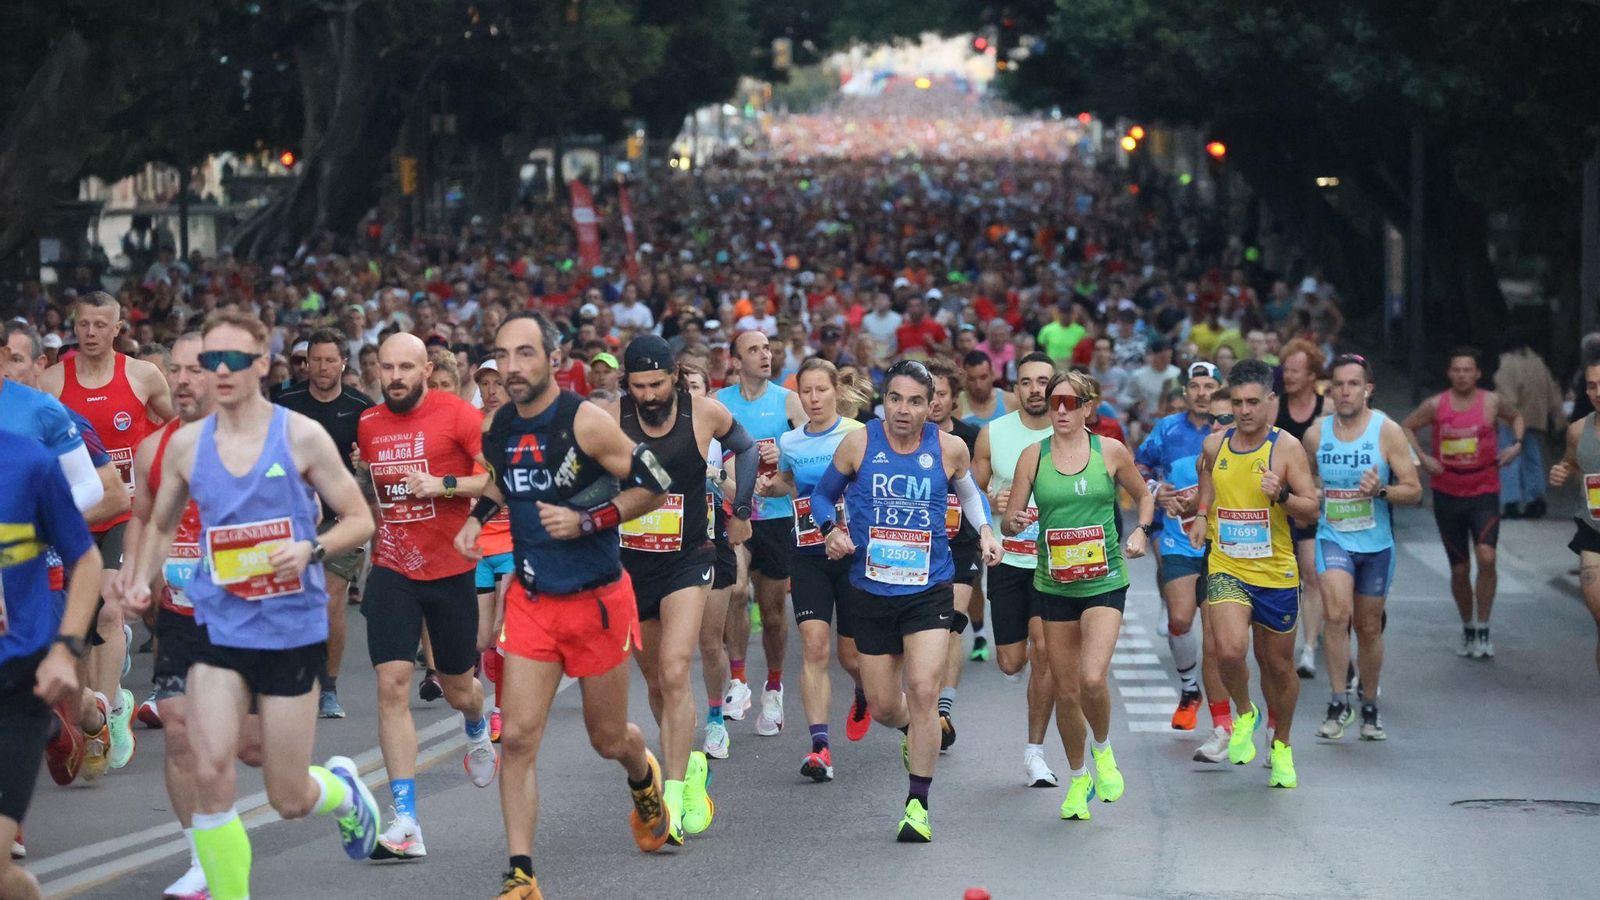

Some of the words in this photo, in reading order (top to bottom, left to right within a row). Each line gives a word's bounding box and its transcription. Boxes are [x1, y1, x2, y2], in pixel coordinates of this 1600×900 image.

[378, 447, 412, 462] MÁLAGA
[1322, 450, 1372, 468] nerja
[382, 464, 422, 475] GENERALI
[872, 473, 931, 500] RCM
[873, 507, 931, 527] 1873
[1229, 511, 1264, 520] GENERALI
[228, 519, 287, 541] GENERALI
[1061, 529, 1100, 540] GENERALI
[1228, 527, 1258, 537] 17699
[881, 547, 917, 561] 12502
[1066, 547, 1087, 559] 827
